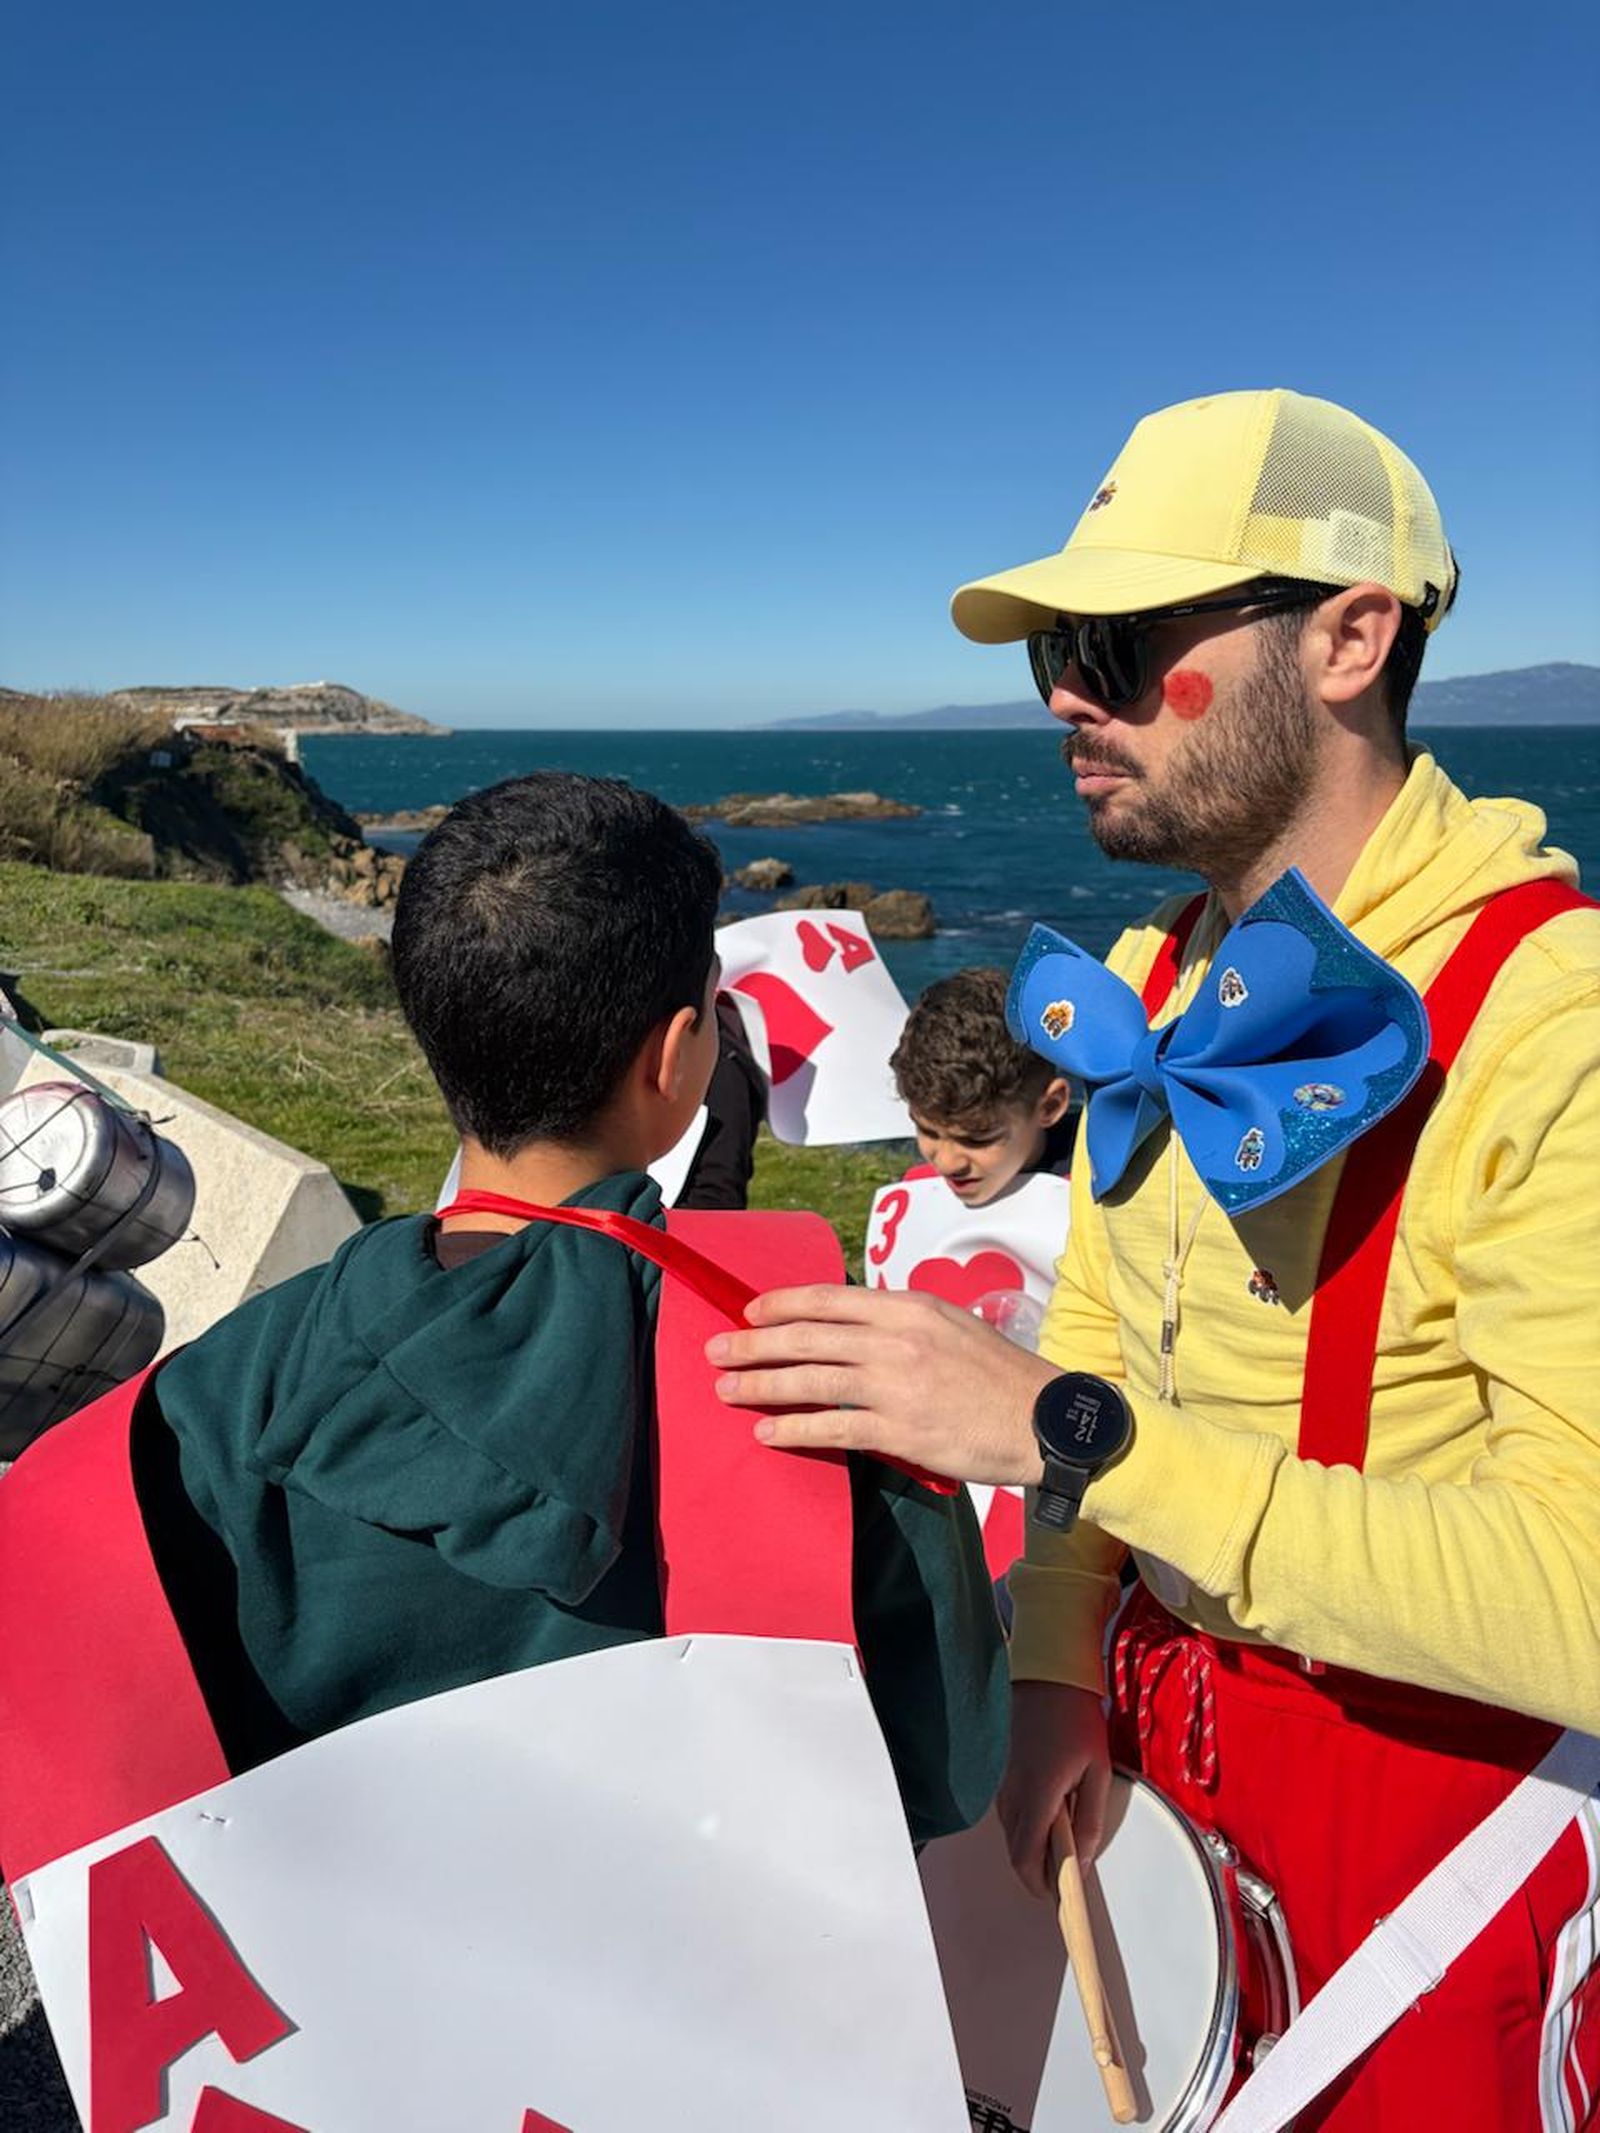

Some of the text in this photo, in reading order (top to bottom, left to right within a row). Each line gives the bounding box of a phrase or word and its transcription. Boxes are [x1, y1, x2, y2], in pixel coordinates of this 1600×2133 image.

[825, 921, 877, 974] A
[869, 1188, 910, 1266] 3
[89, 1836, 294, 2133] A
